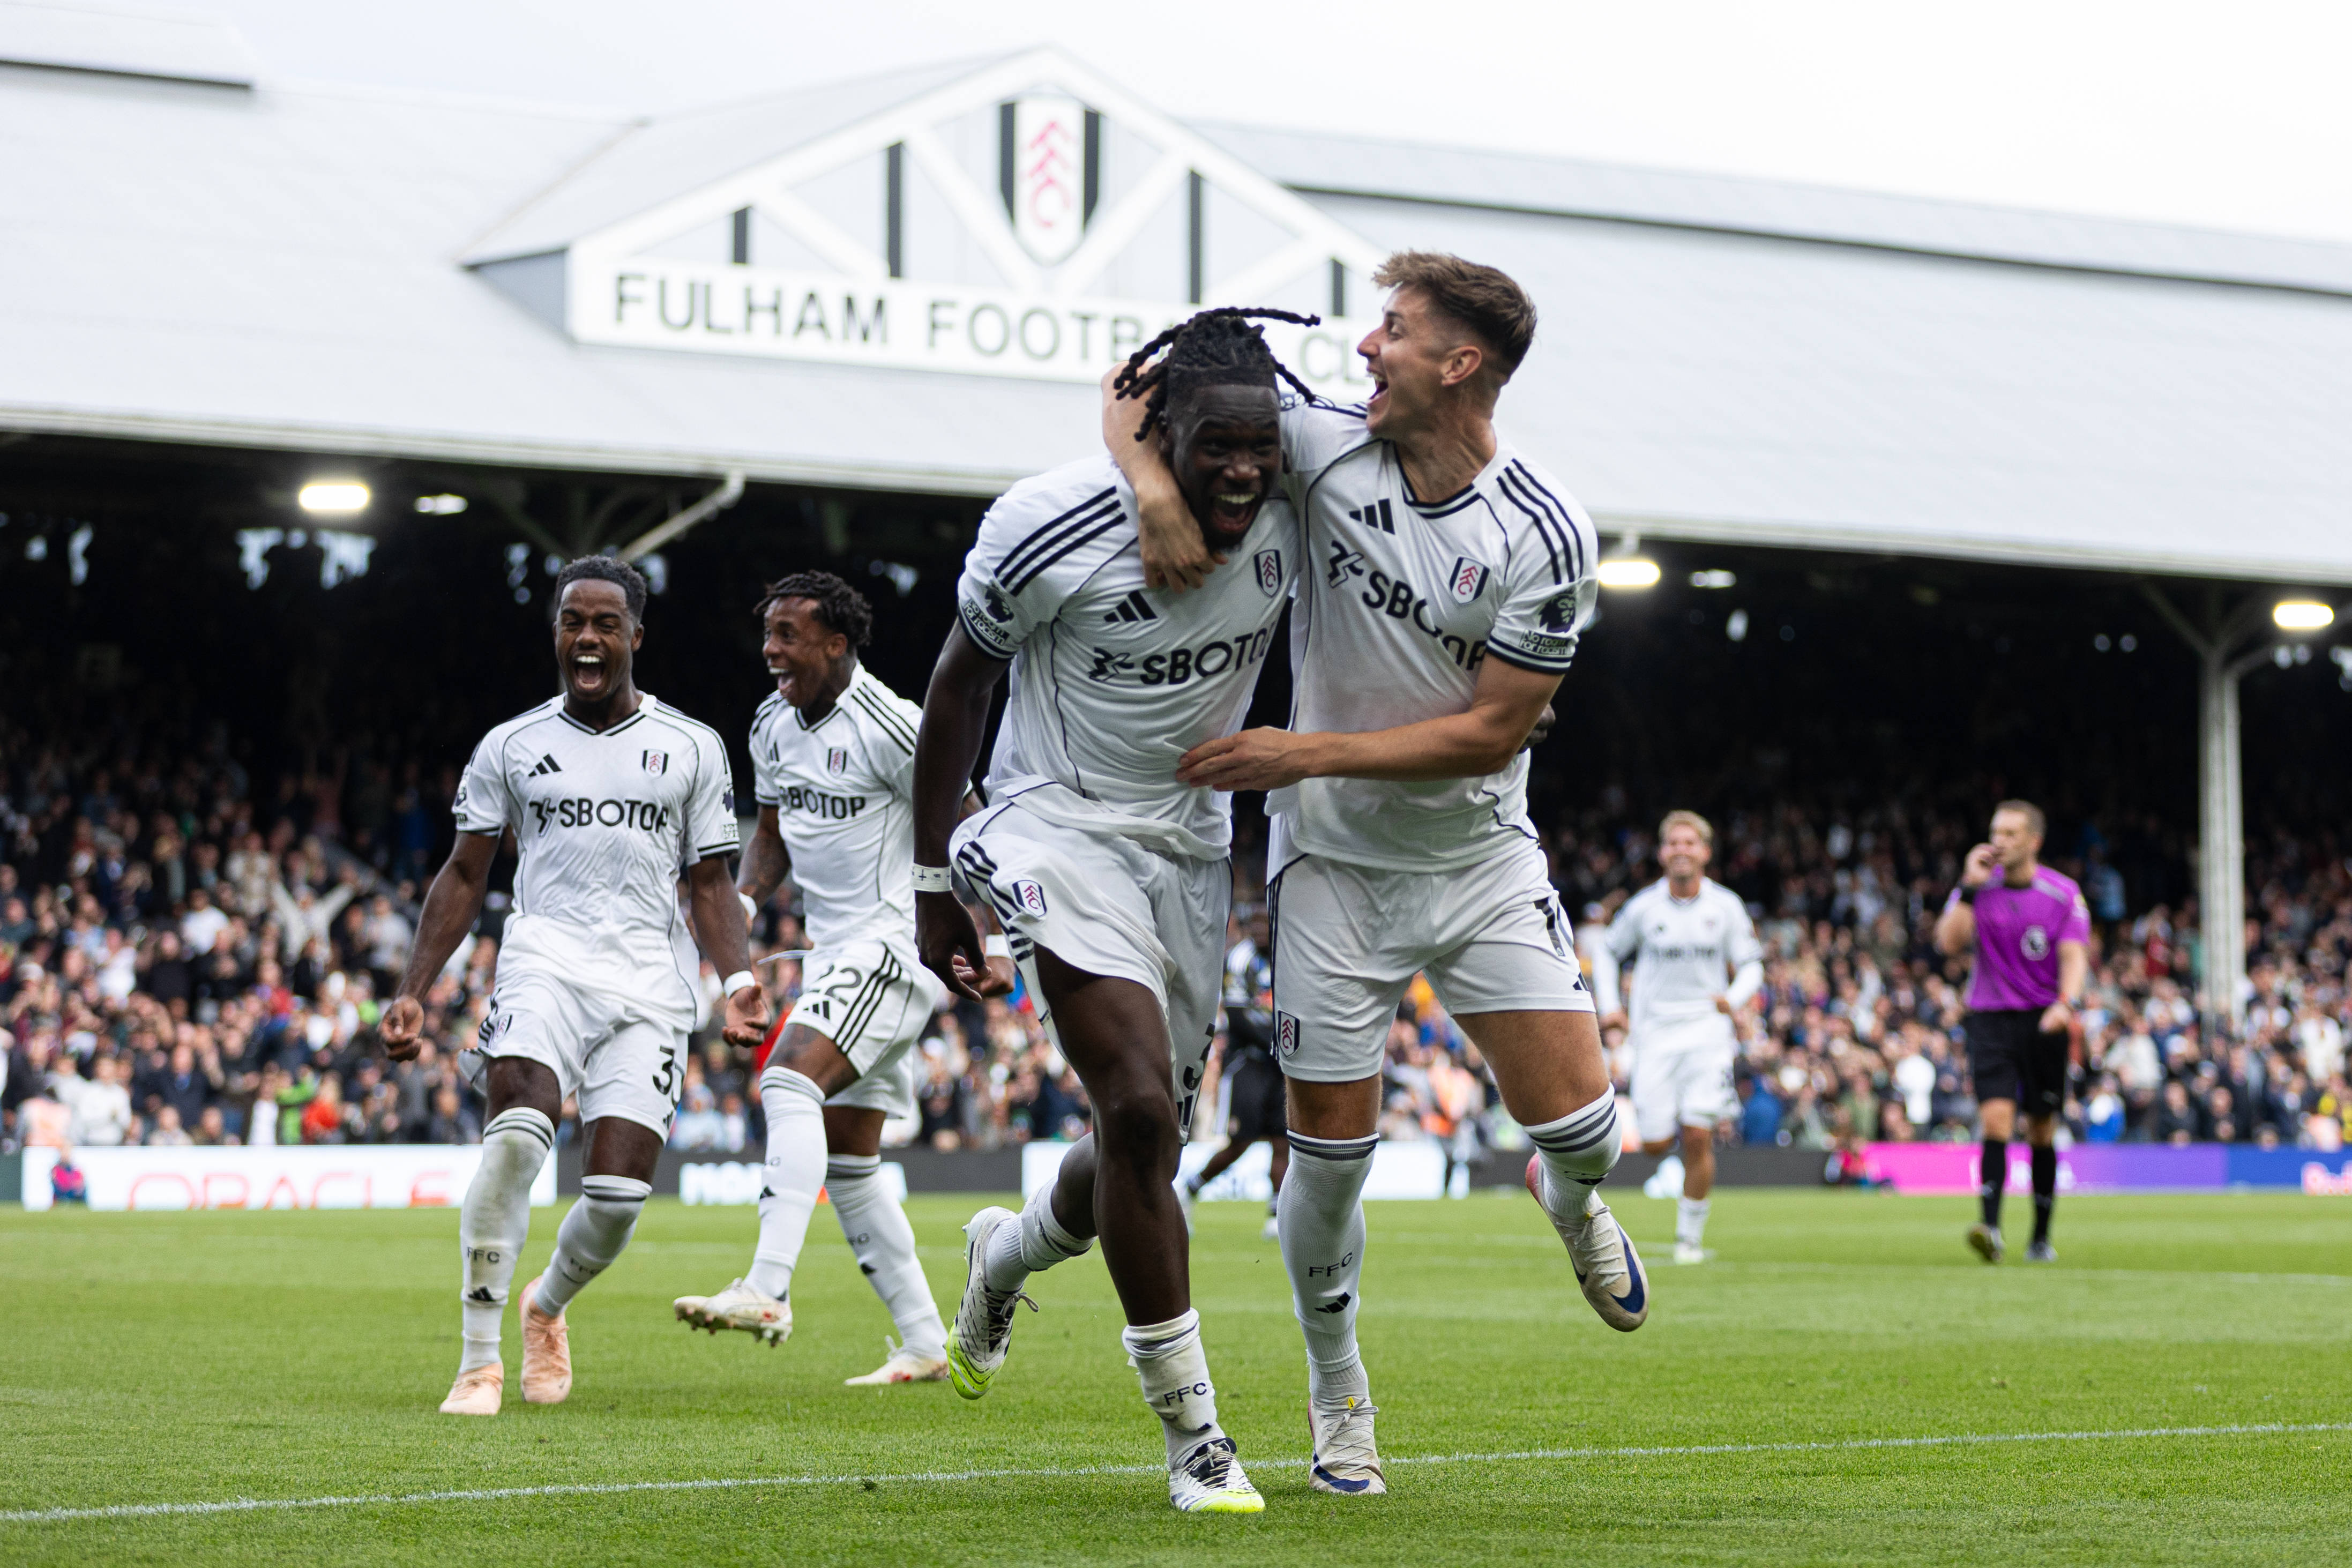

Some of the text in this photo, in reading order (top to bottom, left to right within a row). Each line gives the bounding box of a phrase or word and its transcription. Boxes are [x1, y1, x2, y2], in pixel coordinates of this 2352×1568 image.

[616, 273, 1368, 386] FULHAM FOOTB CL
[1139, 621, 1276, 685] SBOTO
[1024, 884, 1041, 910] FFC
[1281, 1019, 1294, 1049] FFC
[467, 1246, 500, 1263] FFC
[1309, 1252, 1353, 1278] FFC
[1163, 1382, 1207, 1406] FFC
